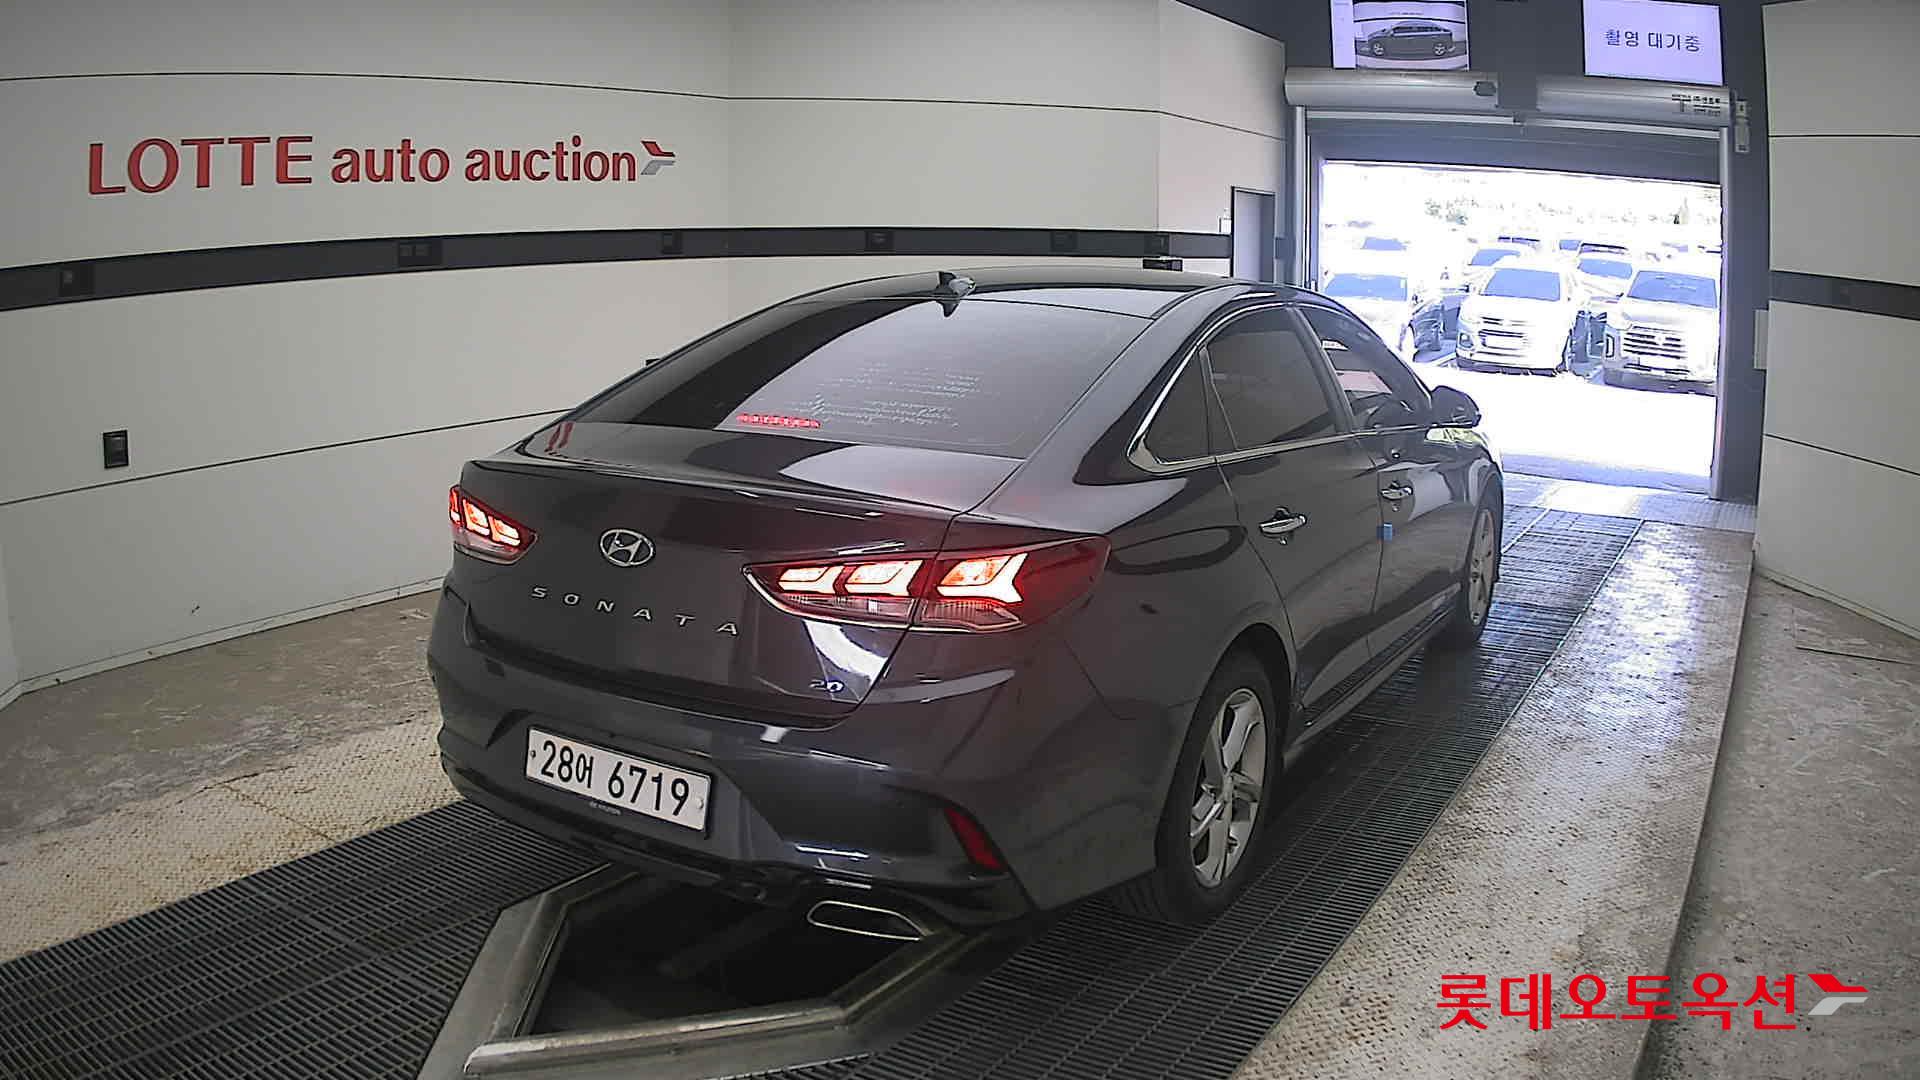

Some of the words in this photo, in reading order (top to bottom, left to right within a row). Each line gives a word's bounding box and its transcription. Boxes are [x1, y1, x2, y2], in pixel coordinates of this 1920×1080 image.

[1647, 32, 1700, 52] 대기중
[88, 135, 313, 195] LOTTE
[331, 138, 450, 184] auto
[465, 135, 637, 182] auction
[531, 586, 739, 637] SONATA
[540, 739, 594, 789] 28어
[607, 760, 691, 817] 6719
